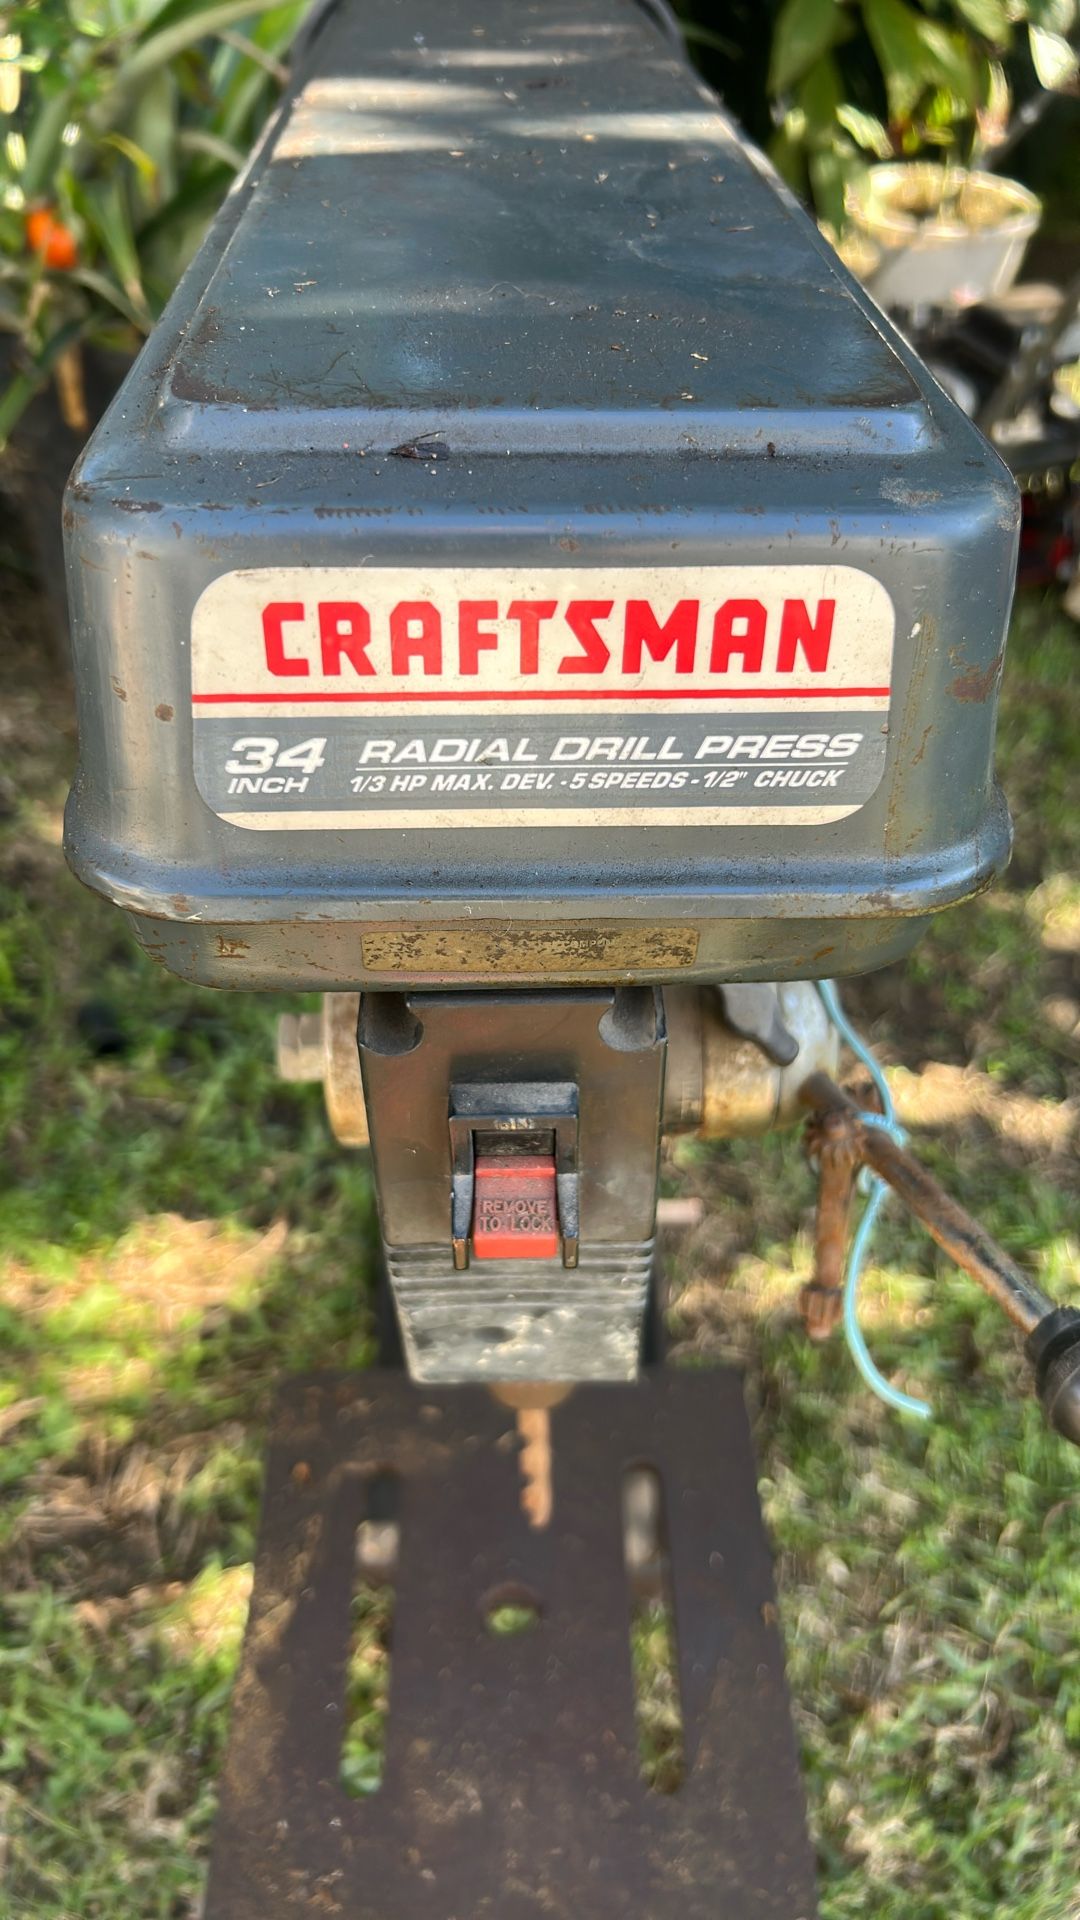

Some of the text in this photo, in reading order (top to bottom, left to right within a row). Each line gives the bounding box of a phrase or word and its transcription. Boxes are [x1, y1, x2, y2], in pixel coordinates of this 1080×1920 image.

[262, 599, 836, 676] CRAFTSMAN
[225, 737, 327, 774] 34
[358, 733, 864, 764] RADIAL DRILL PRESS
[227, 777, 309, 794] INCH
[351, 775, 387, 793] 1/3
[390, 775, 427, 792] HP
[430, 774, 494, 791] MAX.
[500, 772, 553, 790] DEV.
[588, 771, 689, 789] SPEEDS
[703, 770, 749, 788] 1/2"
[754, 769, 845, 788] CHUCK
[482, 1200, 548, 1214] REMOVE
[480, 1215, 552, 1231] TO LOCK
